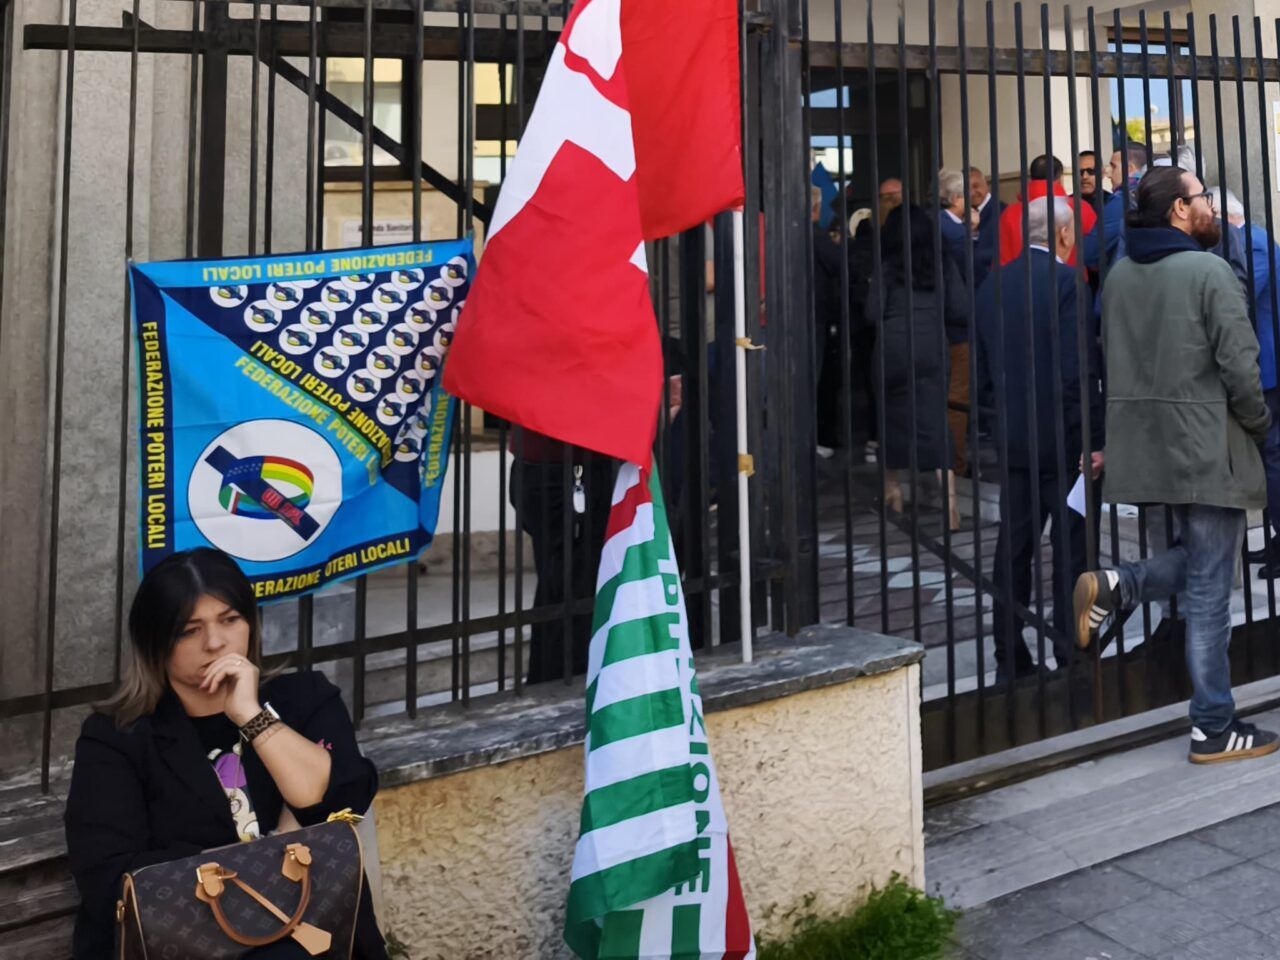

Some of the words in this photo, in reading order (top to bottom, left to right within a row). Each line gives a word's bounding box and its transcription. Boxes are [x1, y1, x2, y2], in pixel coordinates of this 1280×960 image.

[203, 264, 261, 281] LOCALI
[267, 260, 325, 276] POTERI
[331, 249, 432, 273] FEDERAZIONE
[142, 321, 165, 428] FEDERAZIONE
[250, 340, 302, 379] LOCALI
[235, 356, 331, 425] FEDERAZIONE
[327, 415, 370, 462] POTERI
[299, 373, 352, 412] POTERI
[147, 432, 165, 489] POTERI
[147, 494, 166, 548] LOCALI
[251, 569, 322, 598] ERAZIONE
[325, 553, 358, 577] OTERI
[361, 538, 410, 564] LOCALI
